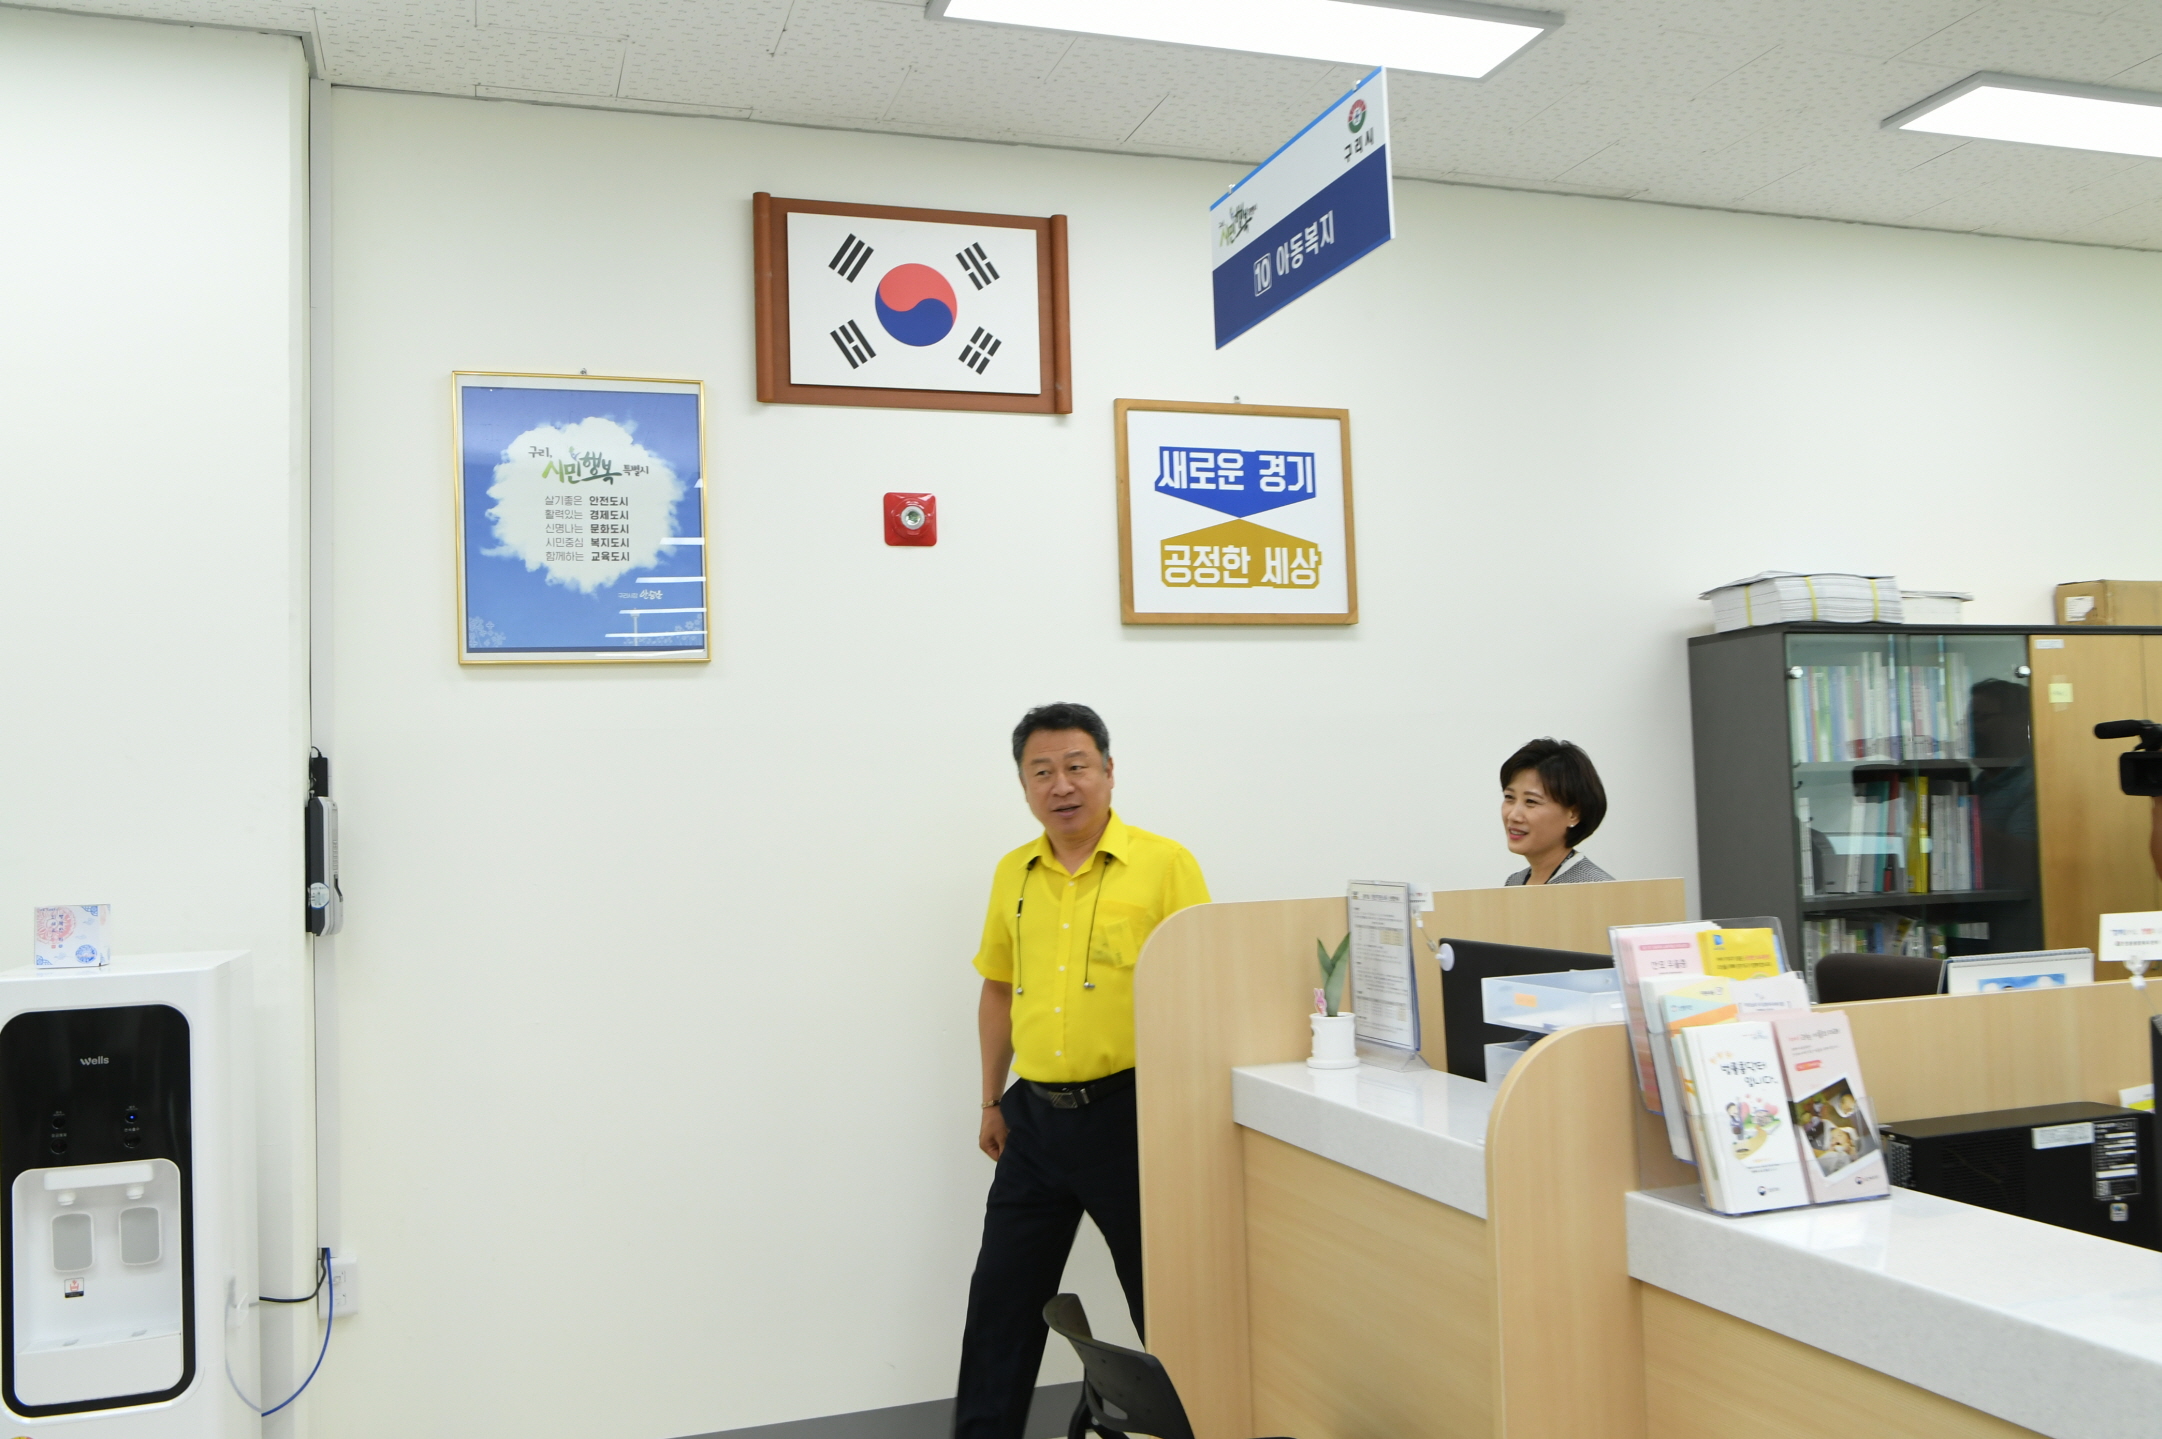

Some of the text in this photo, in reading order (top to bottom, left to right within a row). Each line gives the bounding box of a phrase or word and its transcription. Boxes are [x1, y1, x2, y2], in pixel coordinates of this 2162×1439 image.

[1344, 127, 1374, 163] 구리시
[1254, 210, 1334, 292] 10 아동복지
[528, 445, 553, 459] 구리,
[623, 464, 649, 477] 특별시
[1158, 450, 1314, 494] 새로운 경기
[545, 495, 629, 506] 살기좋은 안전도시
[545, 509, 629, 520] 활력있는 경제도시
[545, 523, 629, 534] 신명나는 문화도시
[545, 537, 630, 548] 시민중심 복지도시
[546, 551, 630, 562] 함께하는 교육도시
[1164, 544, 1319, 586] 공정한 세상
